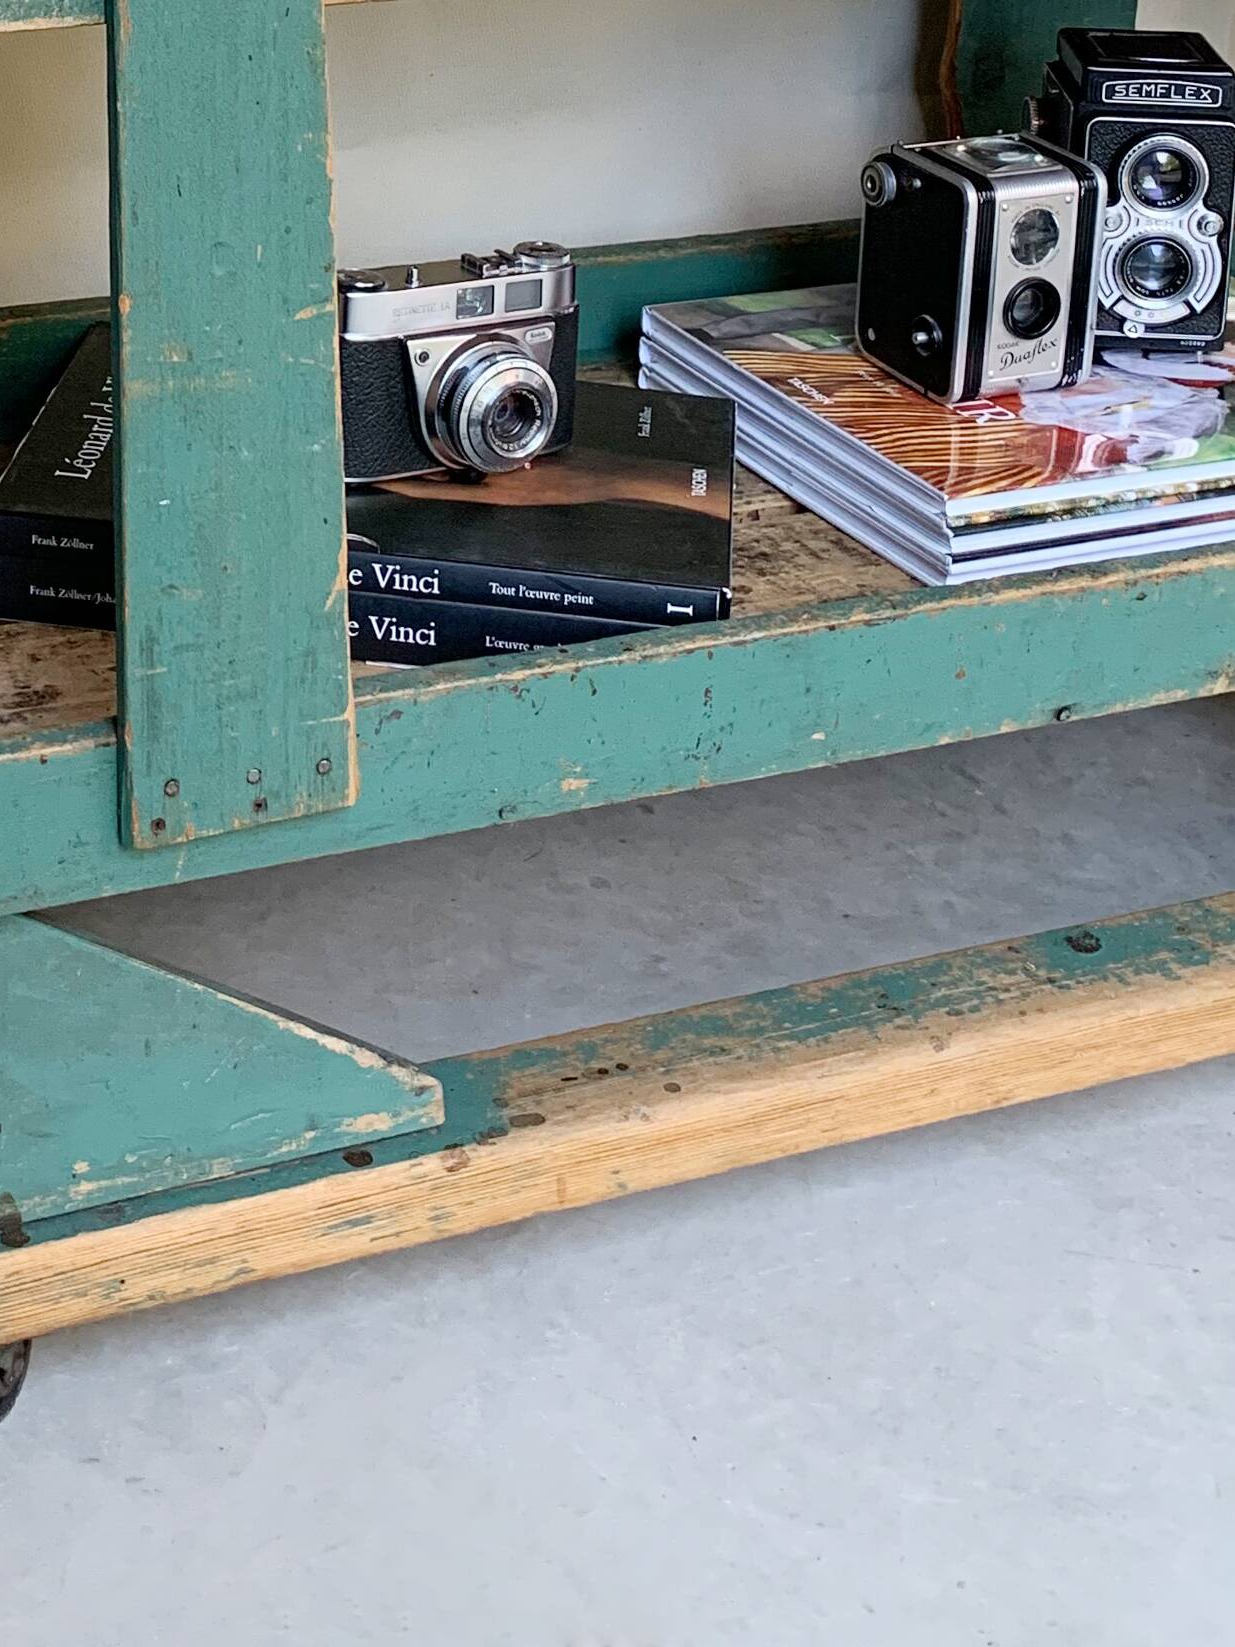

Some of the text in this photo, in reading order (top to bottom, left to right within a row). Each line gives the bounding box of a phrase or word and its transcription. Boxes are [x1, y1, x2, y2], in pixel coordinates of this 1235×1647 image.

[1114, 83, 1213, 103] SEMFLEX
[999, 338, 1058, 371] Duaflex
[786, 376, 835, 406] TASCHEN
[54, 414, 114, 480] Léonard
[690, 468, 708, 497] TASCHEN
[31, 534, 58, 547] Frank
[29, 584, 56, 598] Frank
[371, 562, 441, 595] Vinci
[488, 582, 516, 597] Tout
[563, 592, 594, 606] peint
[367, 615, 437, 646] Vinci
